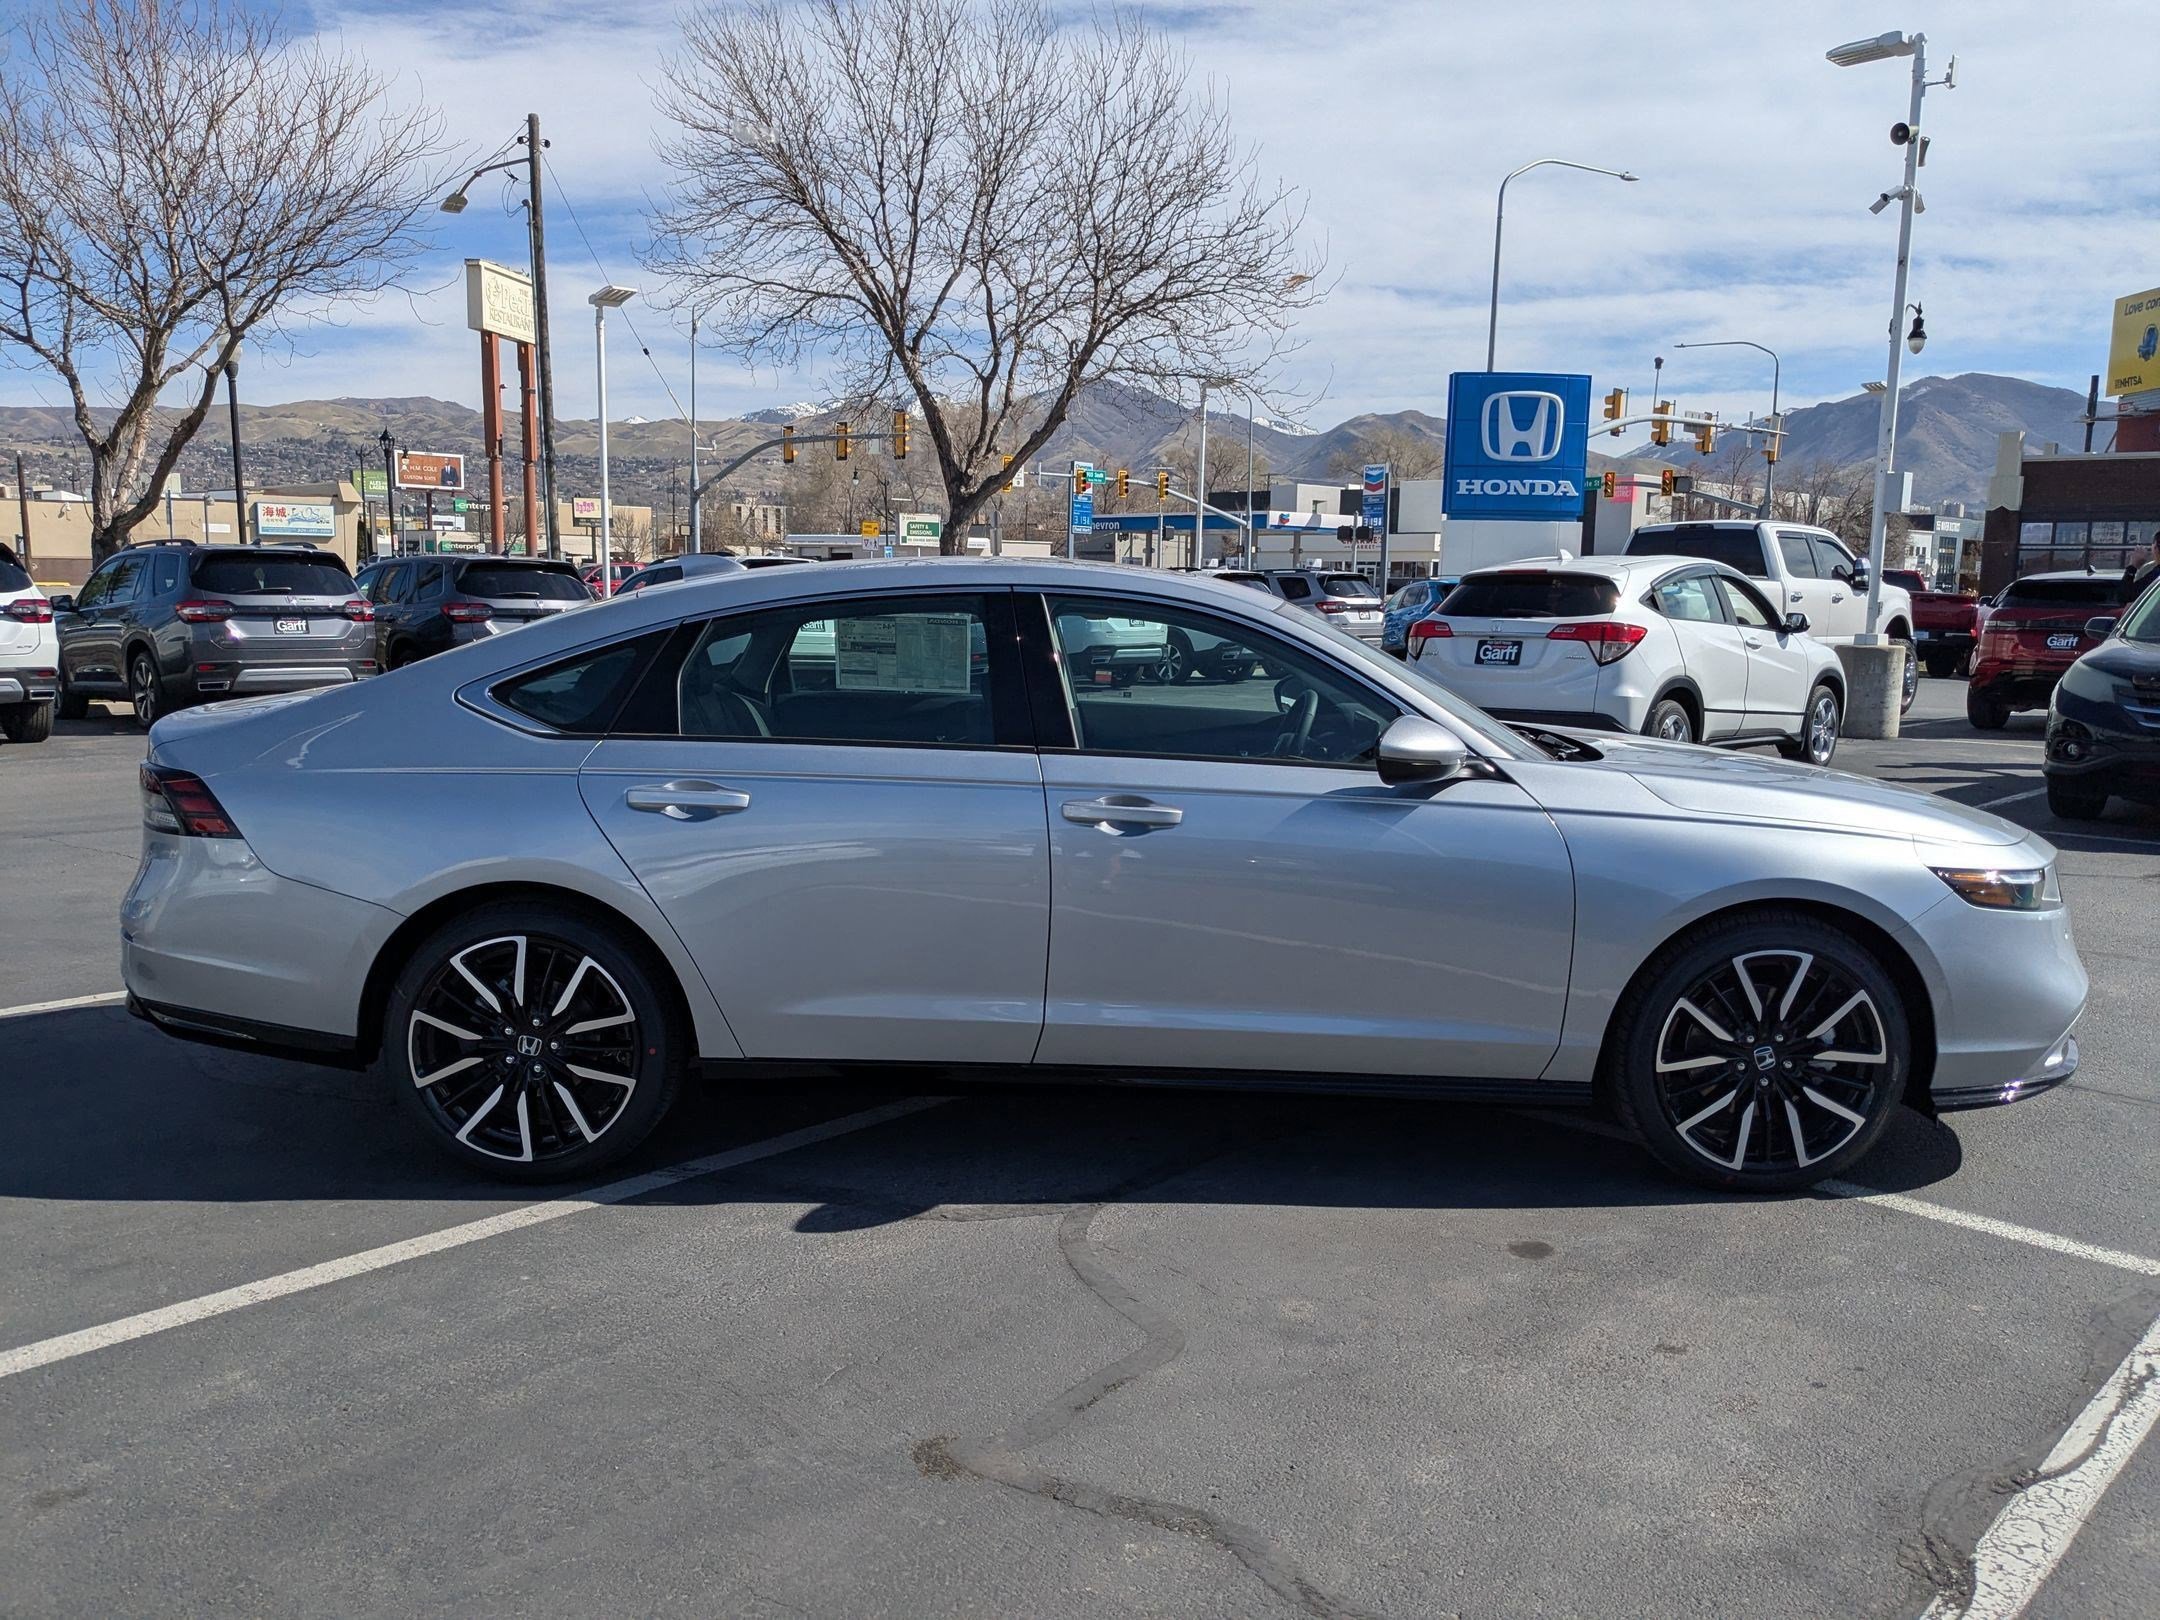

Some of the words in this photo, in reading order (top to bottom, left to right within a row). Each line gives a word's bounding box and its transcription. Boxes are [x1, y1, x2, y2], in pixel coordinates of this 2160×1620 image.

[2124, 303, 2144, 316] Love
[2120, 376, 2143, 388] NHTSA
[1456, 479, 1579, 497] HONDA
[276, 621, 307, 633] Garff
[2047, 636, 2079, 647] Garff
[1480, 645, 1519, 660] Garff
